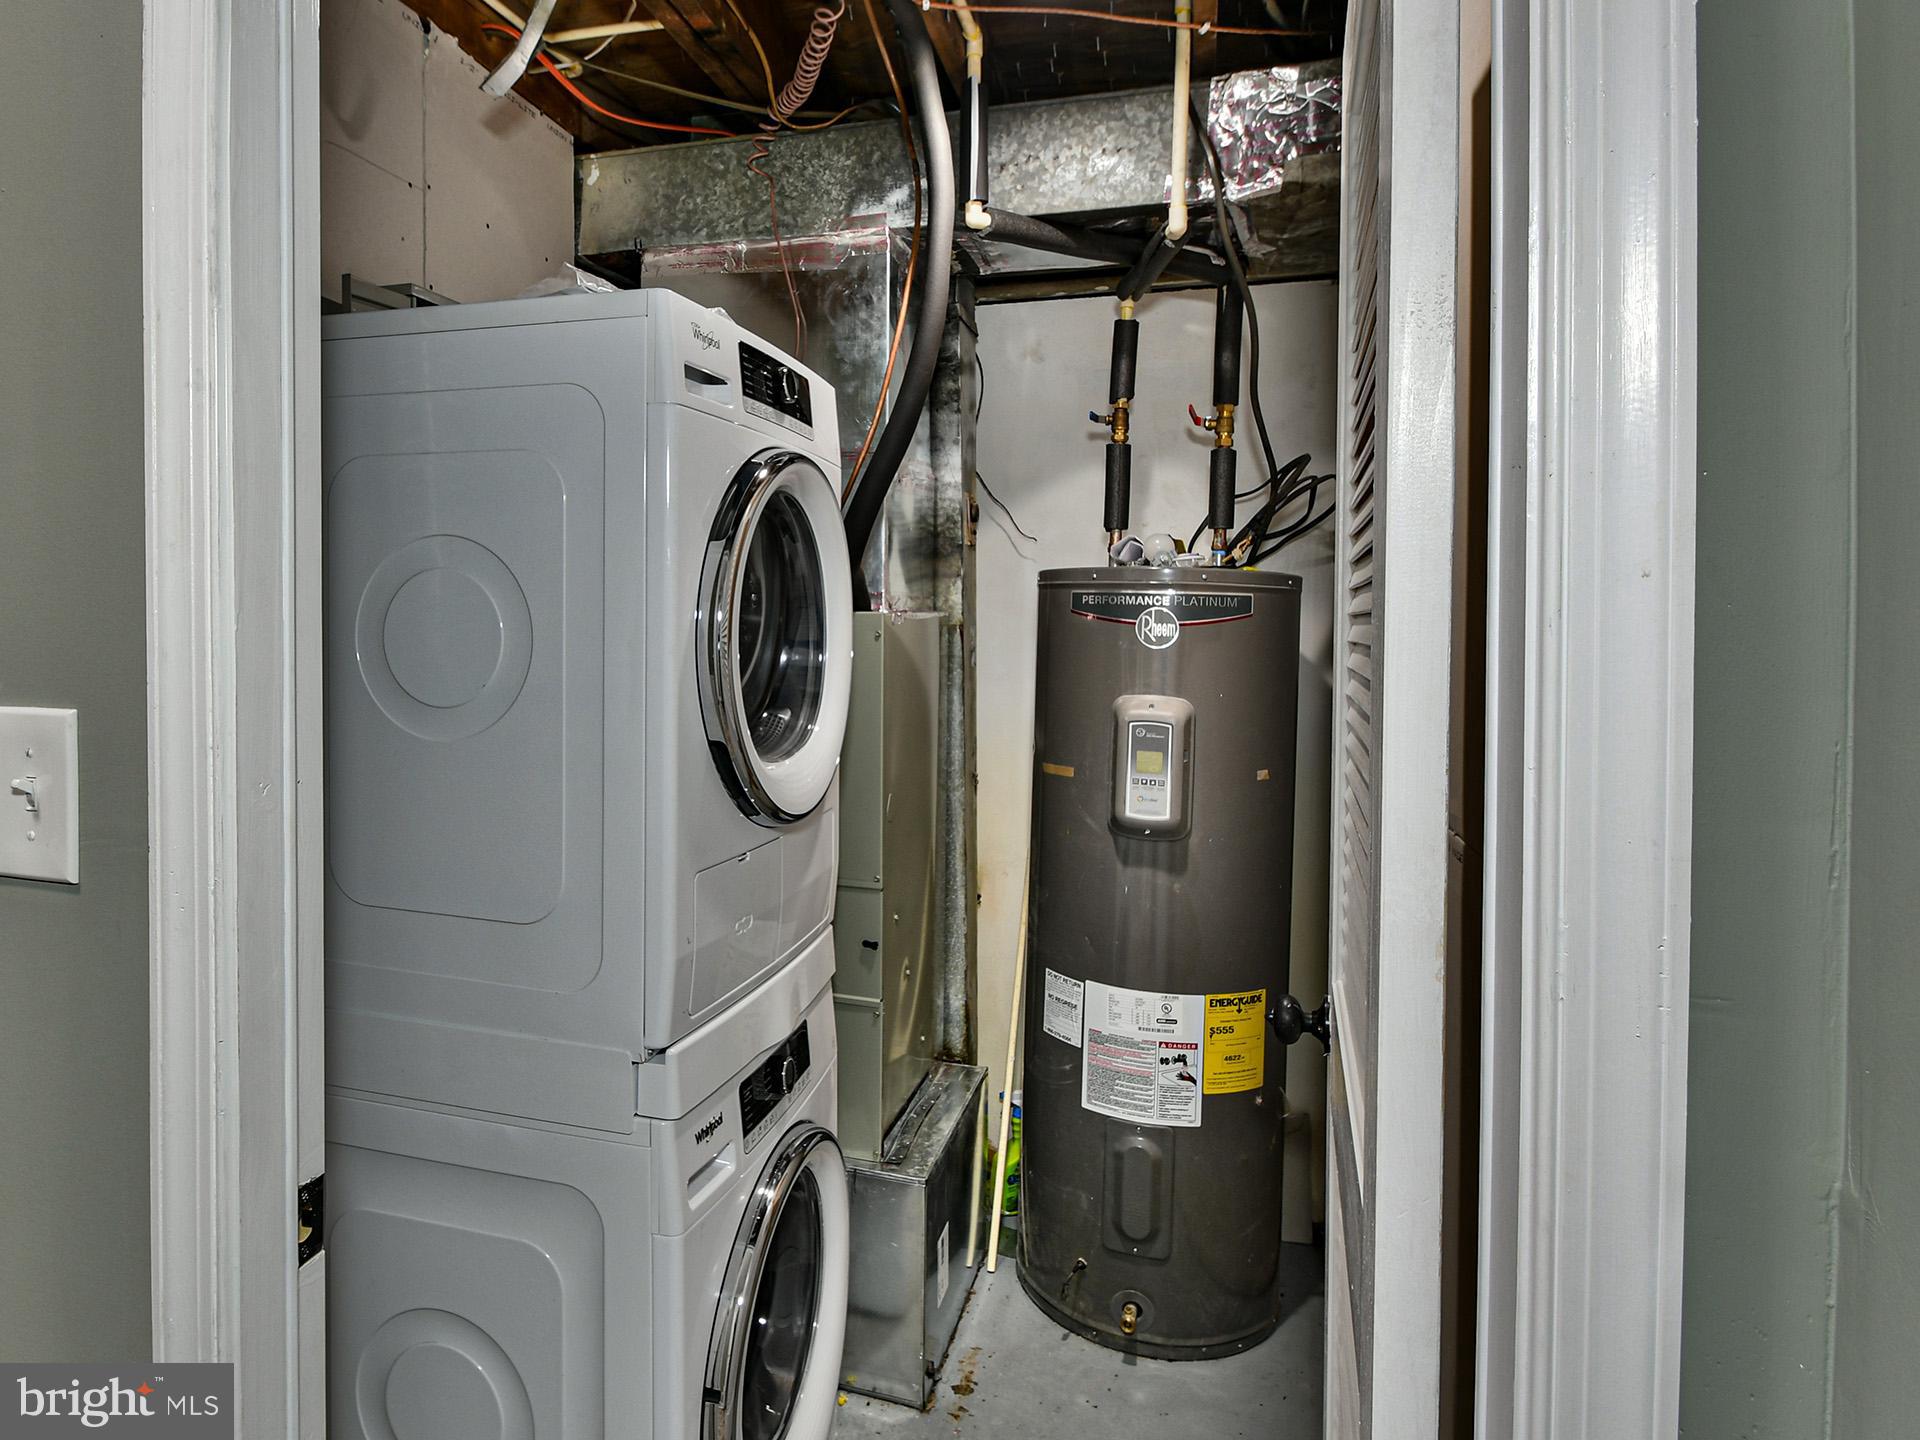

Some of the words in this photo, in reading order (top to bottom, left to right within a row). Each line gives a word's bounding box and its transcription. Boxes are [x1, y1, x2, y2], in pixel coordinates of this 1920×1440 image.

[691, 326, 720, 351] Whirlpool
[1082, 594, 1170, 607] PERFORMANCE
[1174, 596, 1238, 608] PLATINUM
[1140, 609, 1176, 643] Rheem
[1062, 977, 1082, 989] RETURN
[1209, 1025, 1235, 1036] $555
[694, 1111, 724, 1144] Whirlpool
